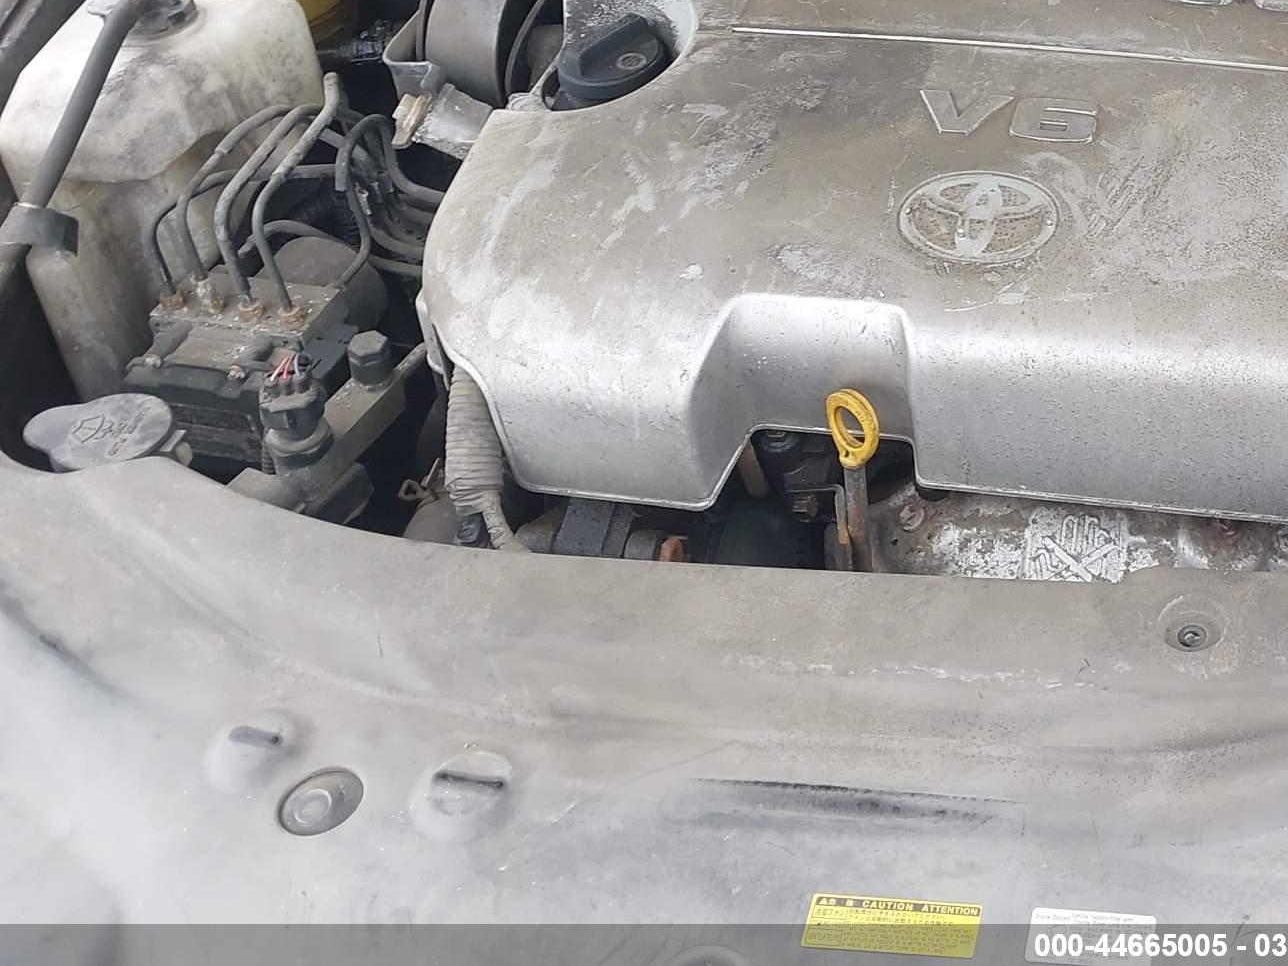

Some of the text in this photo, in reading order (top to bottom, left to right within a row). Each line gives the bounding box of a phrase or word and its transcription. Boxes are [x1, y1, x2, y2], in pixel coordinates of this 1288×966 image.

[919, 89, 1100, 143] V6
[862, 900, 914, 911] CAUTION
[921, 904, 979, 916] ATTENTION
